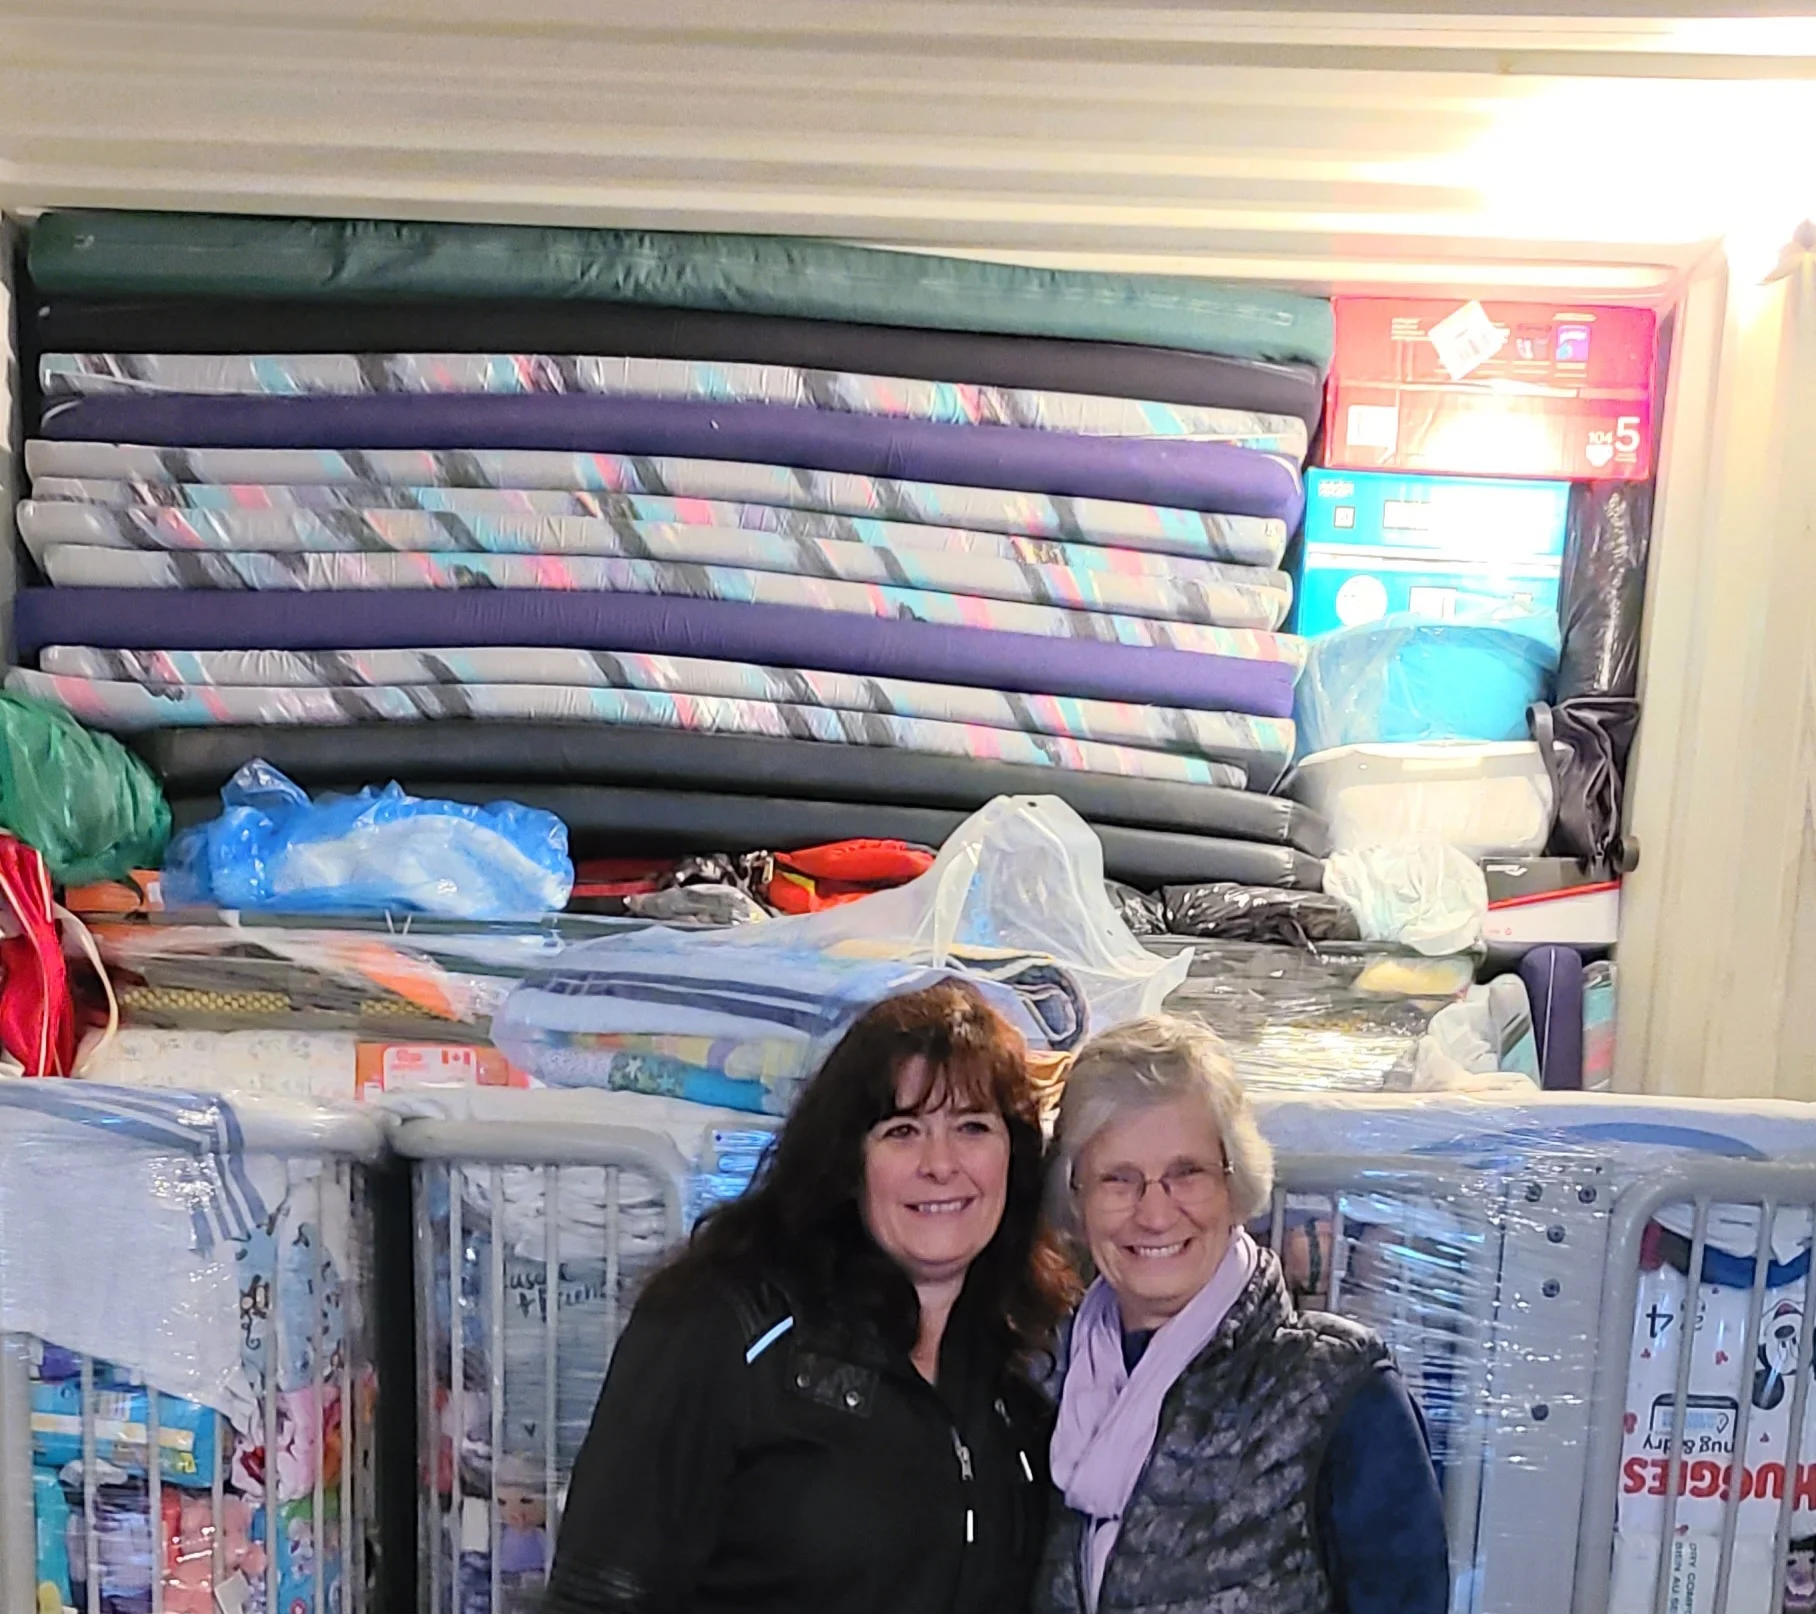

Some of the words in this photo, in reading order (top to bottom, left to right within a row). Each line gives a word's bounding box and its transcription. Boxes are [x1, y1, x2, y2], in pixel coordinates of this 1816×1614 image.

[1588, 430, 1613, 445] 104
[1614, 415, 1641, 453] 5
[1646, 1303, 1675, 1339] 4
[1698, 1436, 1735, 1455] nug
[1623, 1456, 1816, 1511] HUGGIES
[1674, 1541, 1684, 1573] BIEN
[1688, 1542, 1698, 1568] DRY
[1672, 1576, 1682, 1595] AU
